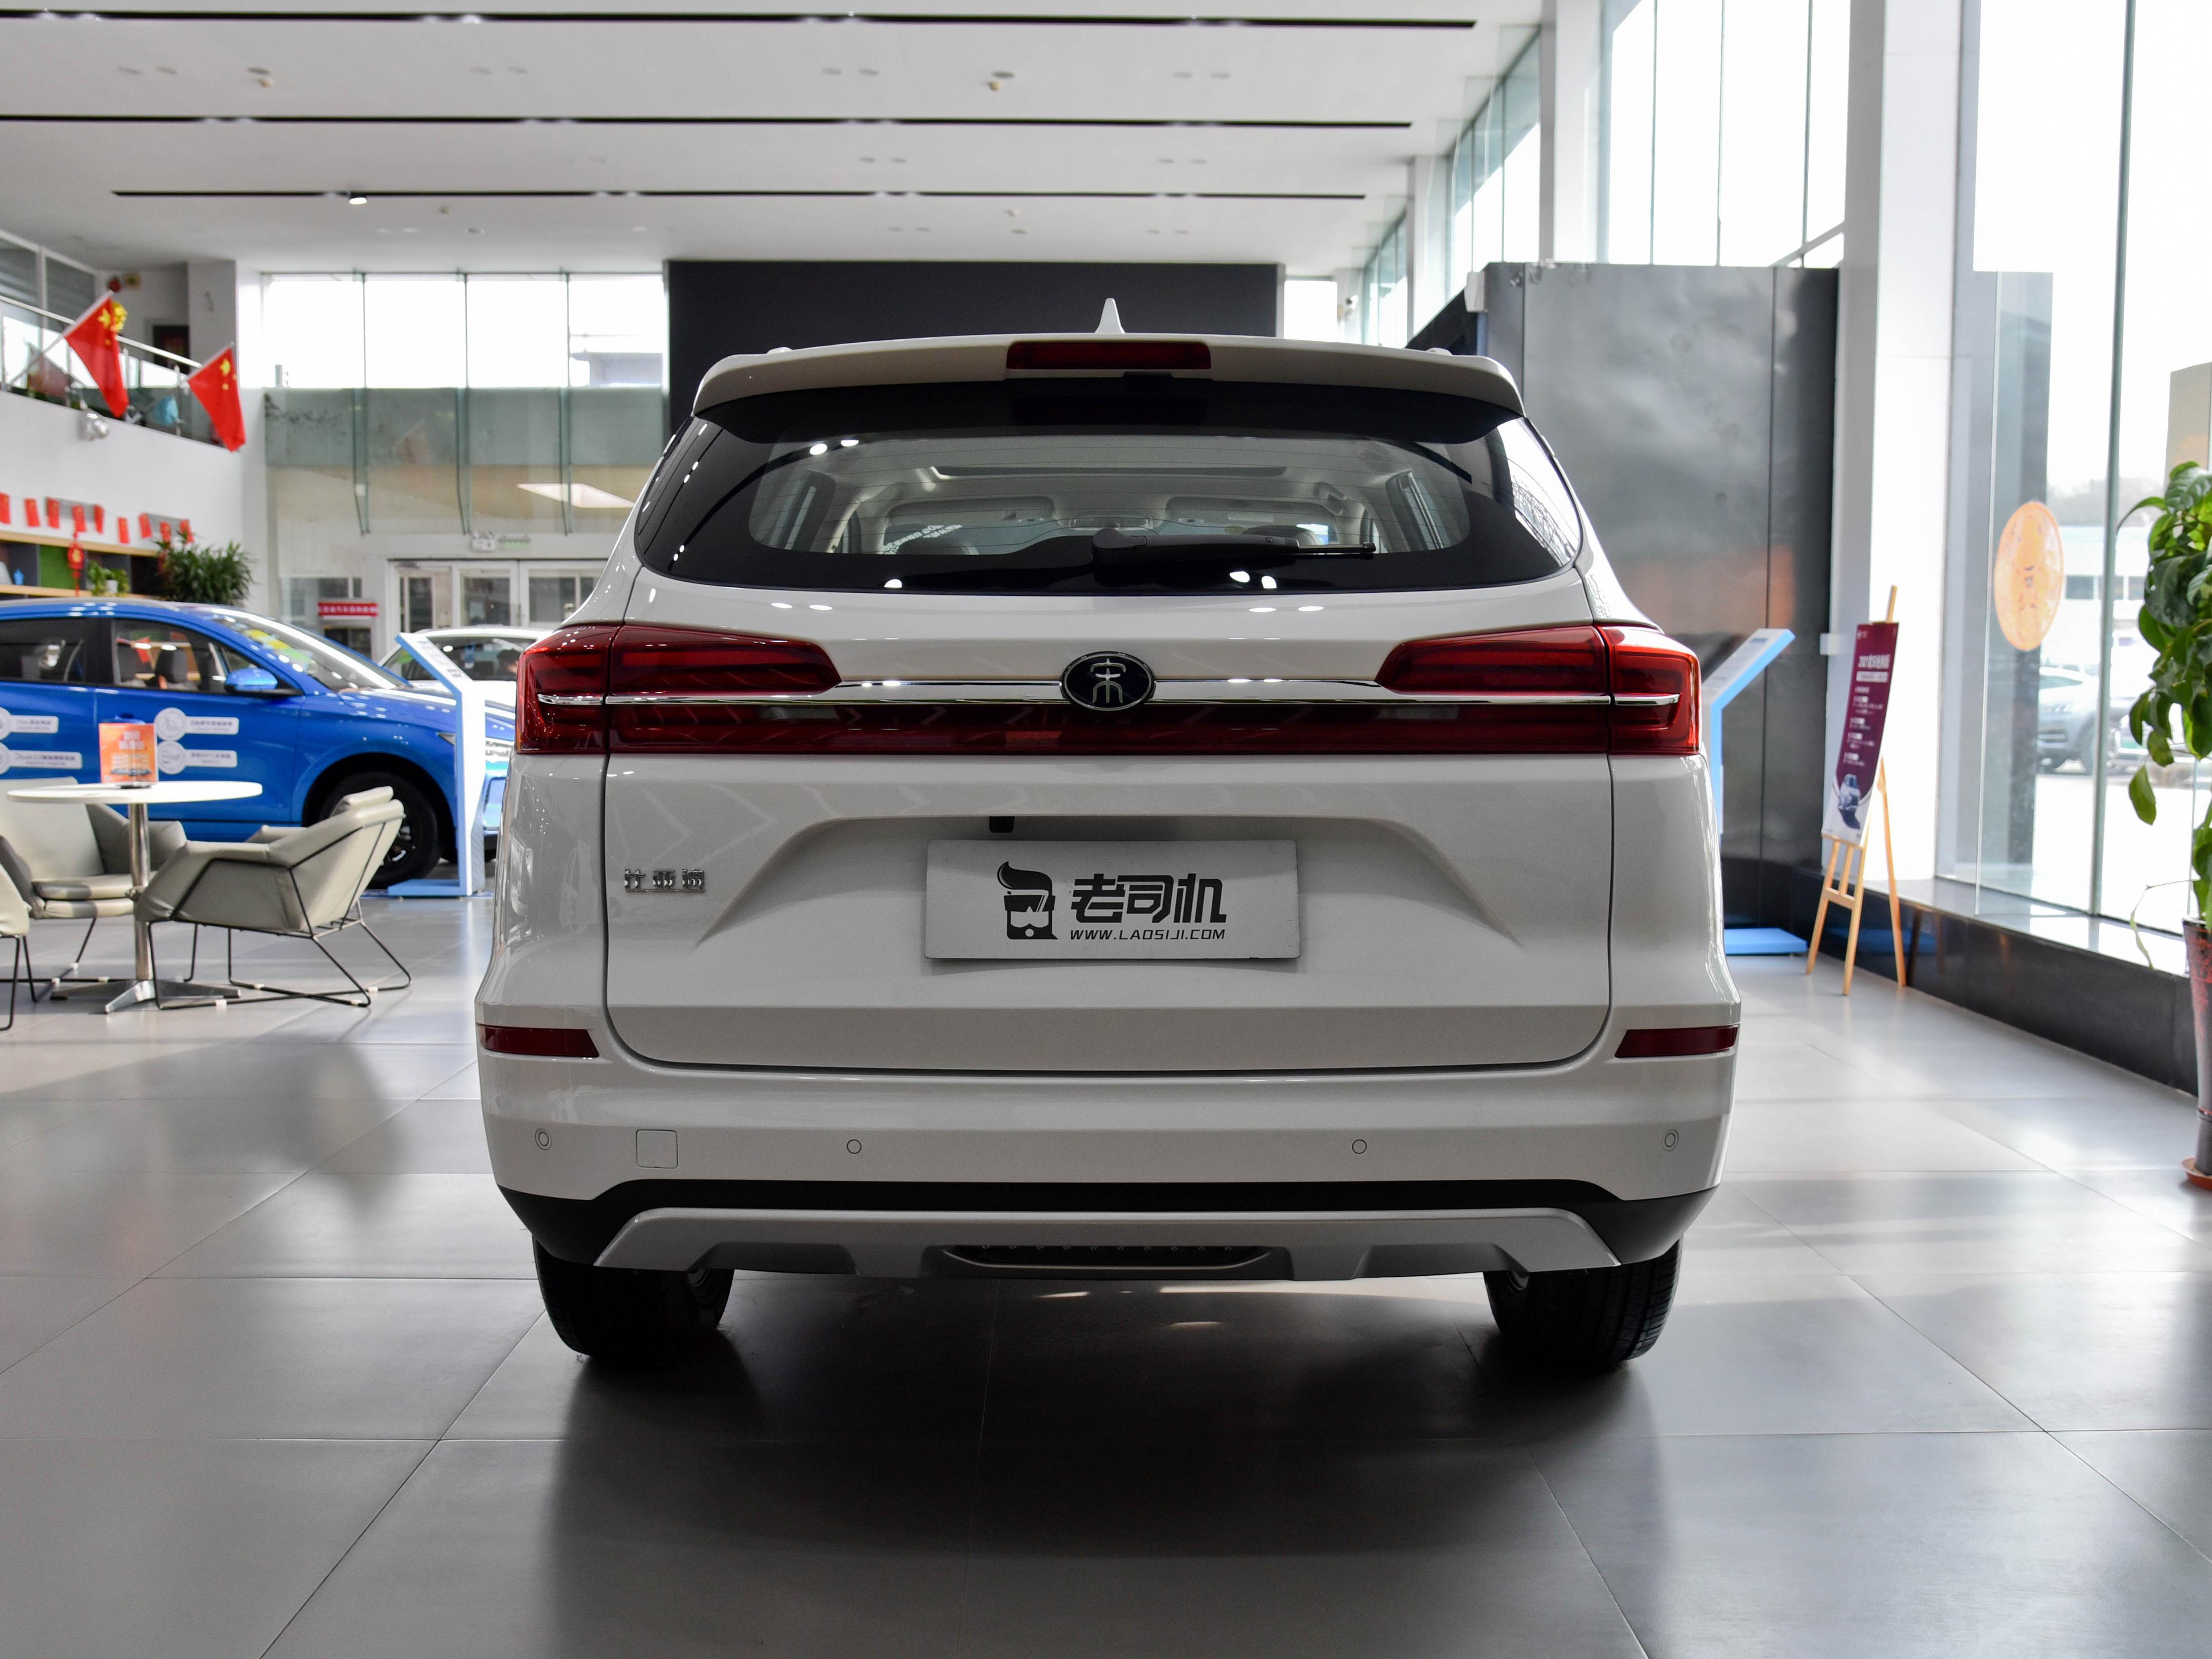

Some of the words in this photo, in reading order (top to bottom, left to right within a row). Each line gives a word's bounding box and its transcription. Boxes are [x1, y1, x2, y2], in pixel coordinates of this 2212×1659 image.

[624, 868, 704, 889] 比亚迪
[1071, 873, 1226, 923] 老司机
[1071, 930, 1225, 940] WWW.LAOSIJI.COM
